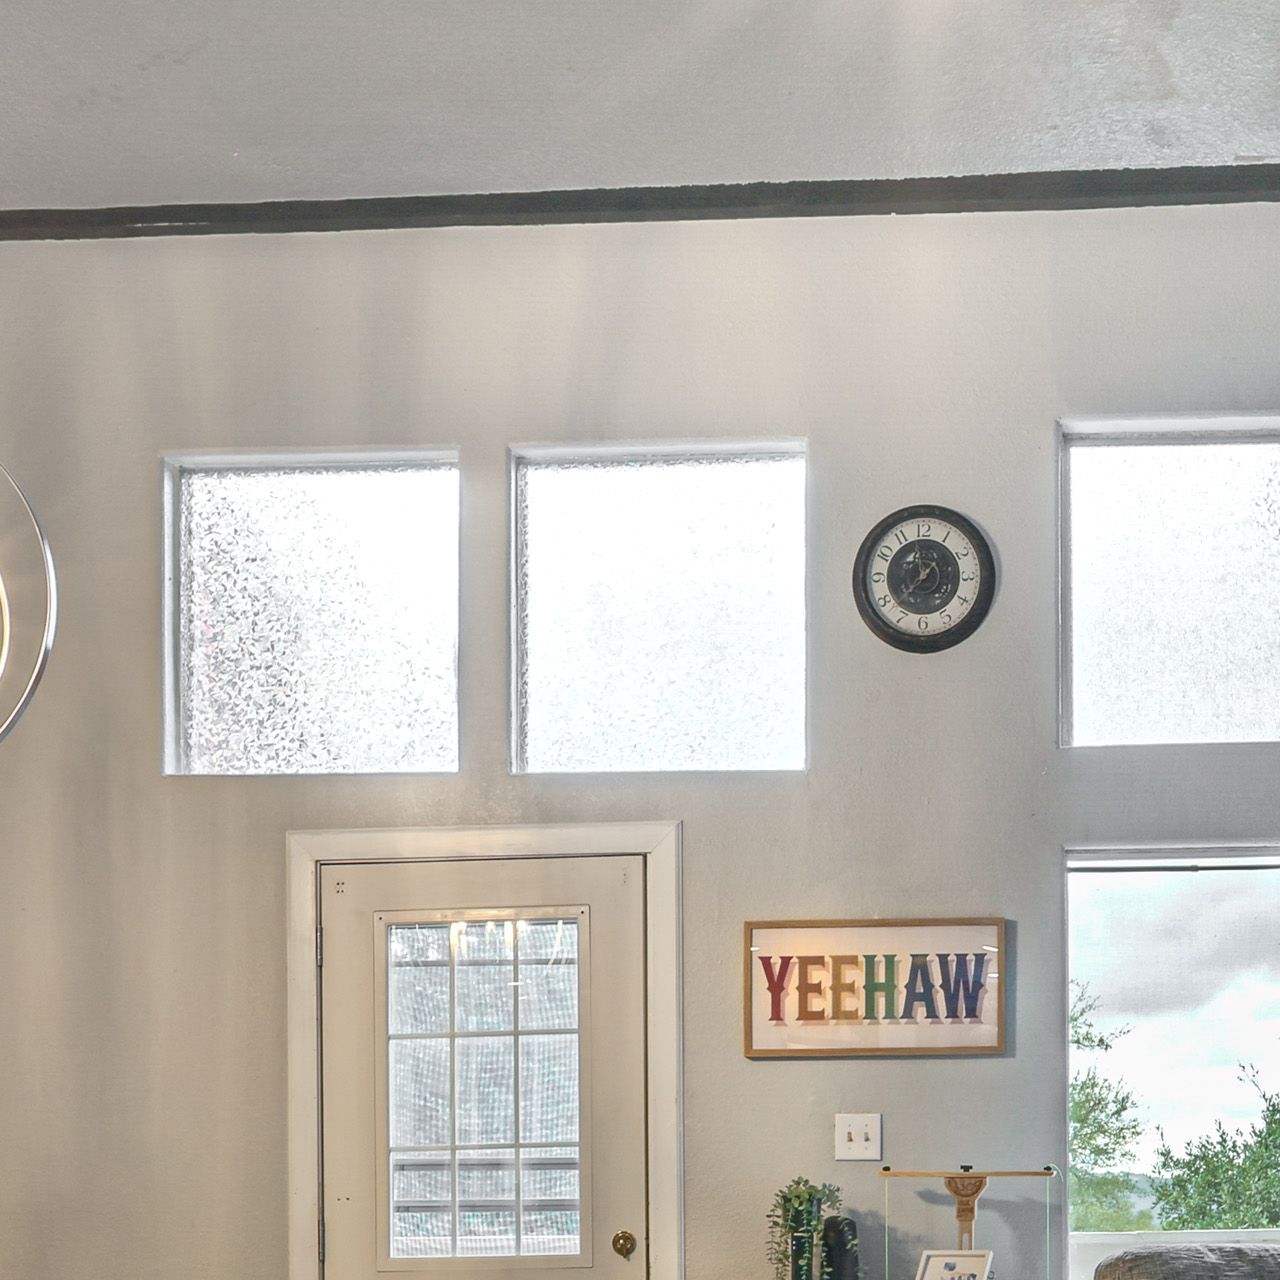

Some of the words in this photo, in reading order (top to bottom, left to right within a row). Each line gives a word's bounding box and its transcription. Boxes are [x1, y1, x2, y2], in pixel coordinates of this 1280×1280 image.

[894, 529, 908, 545] 11
[916, 523, 931, 538] 12
[942, 530, 951, 543] 1
[876, 545, 893, 562] 10
[955, 546, 969, 560] 2
[871, 572, 886, 583] 9
[961, 571, 975, 582] 3
[877, 594, 891, 608] 8
[957, 594, 969, 606] 4
[896, 610, 909, 624] 7
[917, 616, 929, 630] 6
[939, 608, 952, 625] 5
[758, 953, 990, 1024] YEEHAW
